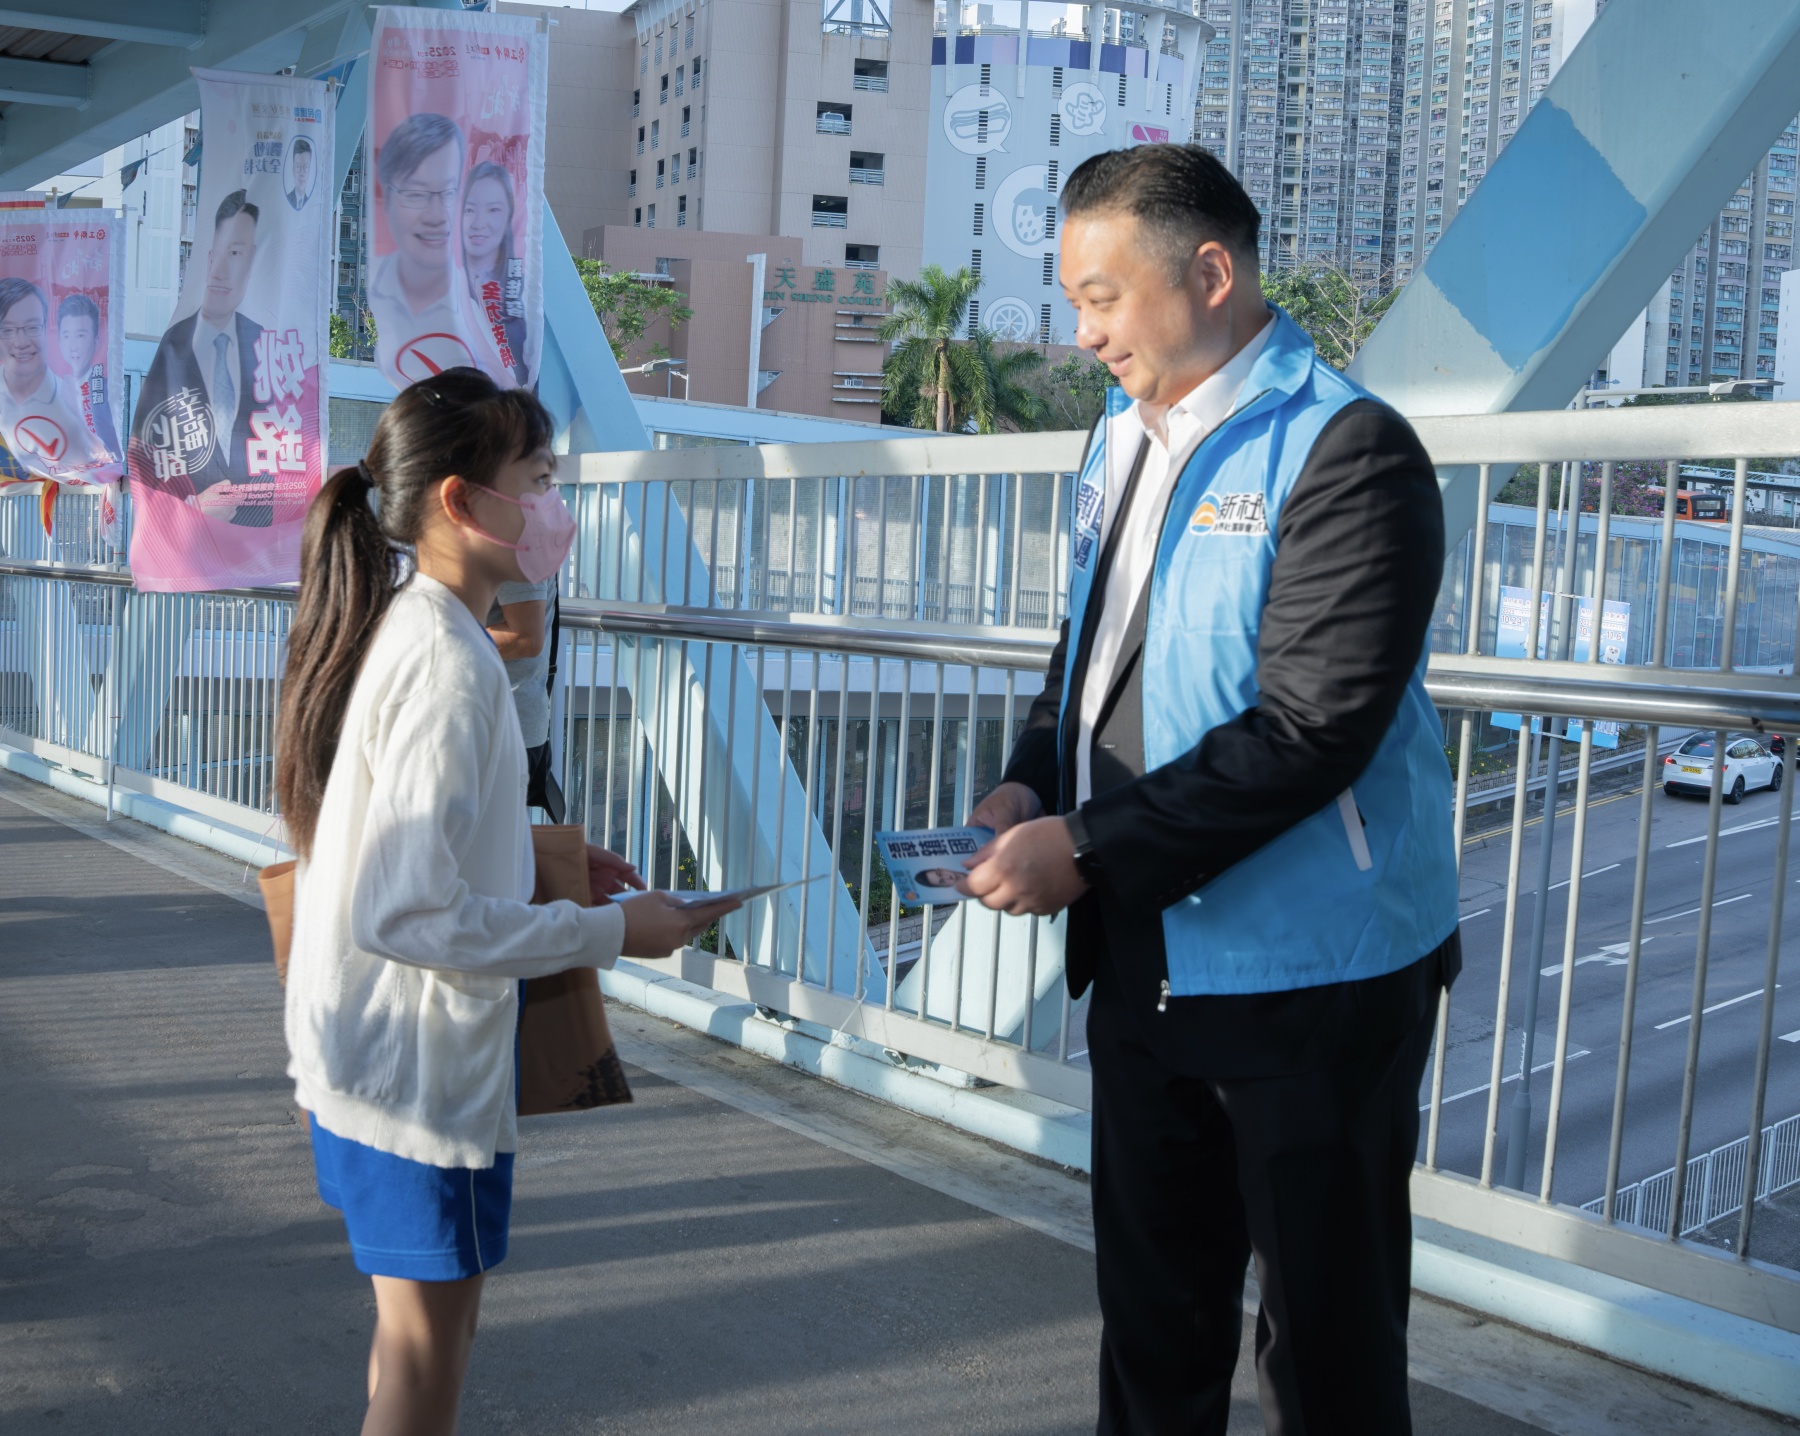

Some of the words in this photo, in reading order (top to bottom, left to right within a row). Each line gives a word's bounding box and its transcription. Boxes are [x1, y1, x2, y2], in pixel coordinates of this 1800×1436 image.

[775, 267, 875, 294] 天盛苑
[764, 291, 785, 300] TIN
[791, 293, 834, 303] SHING
[839, 296, 882, 306] COURT
[1219, 493, 1266, 521] 新社
